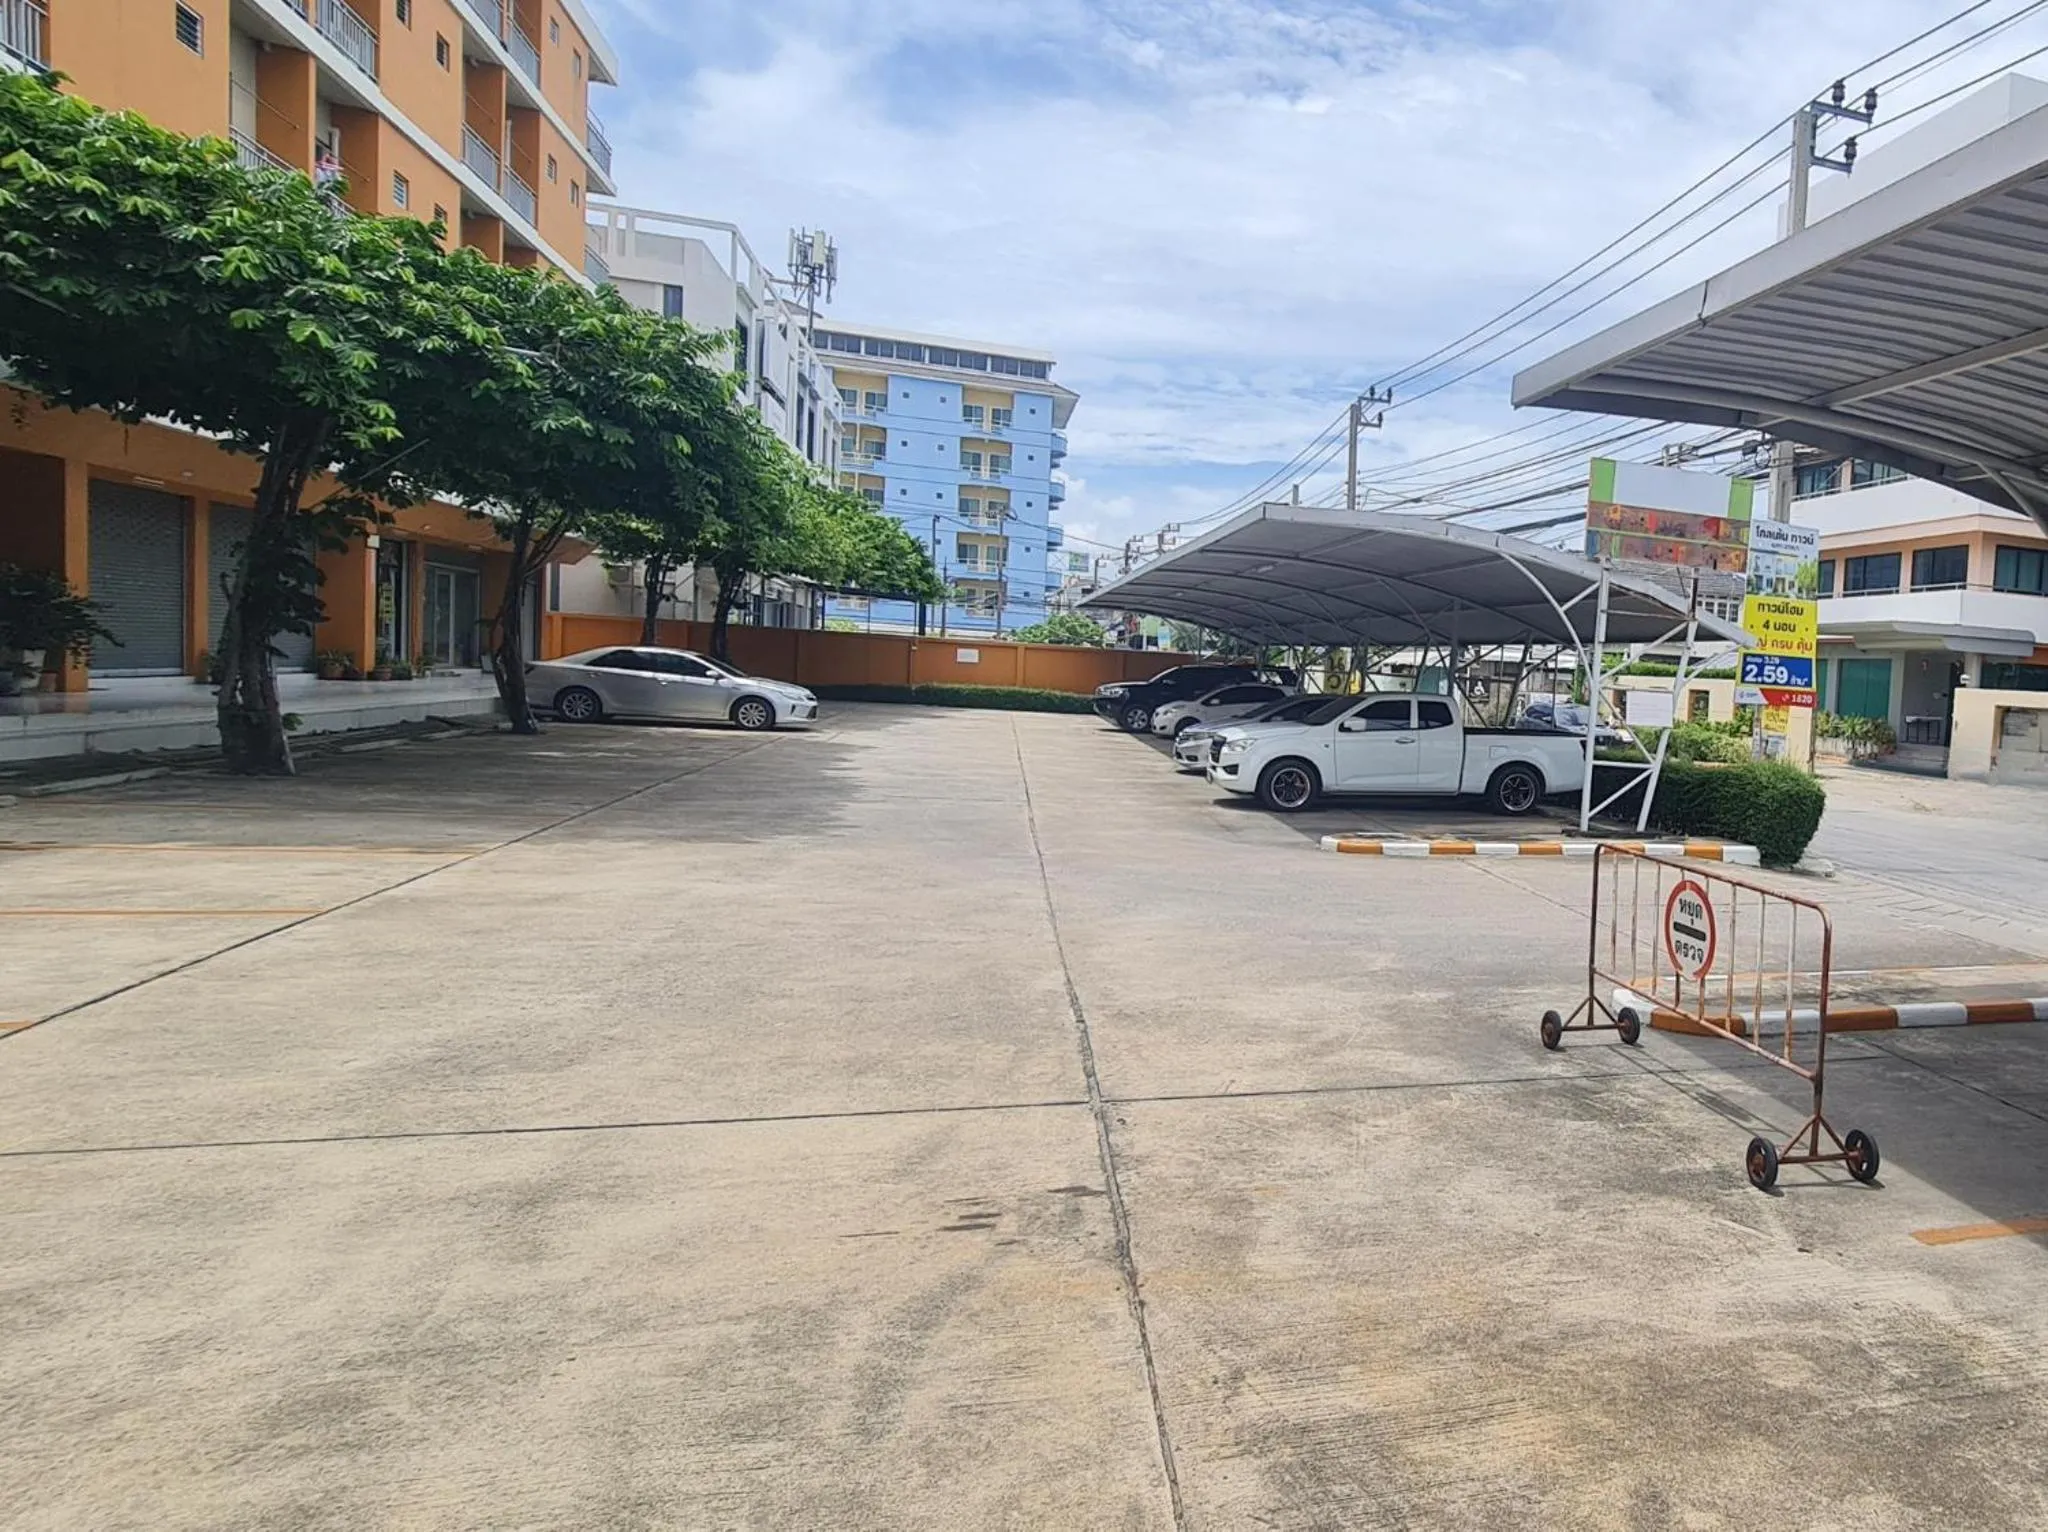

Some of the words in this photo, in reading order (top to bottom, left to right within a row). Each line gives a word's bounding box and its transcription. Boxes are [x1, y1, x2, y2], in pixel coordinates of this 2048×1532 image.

[1790, 533, 1815, 545] ทาวน์
[1757, 602, 1804, 616] ทาวน์โฮม
[1762, 619, 1770, 630] 4
[1773, 621, 1797, 633] นอน
[1744, 664, 1788, 684] 2.59
[1679, 898, 1703, 925] หยุด
[1675, 940, 1705, 964] ตรวจ
